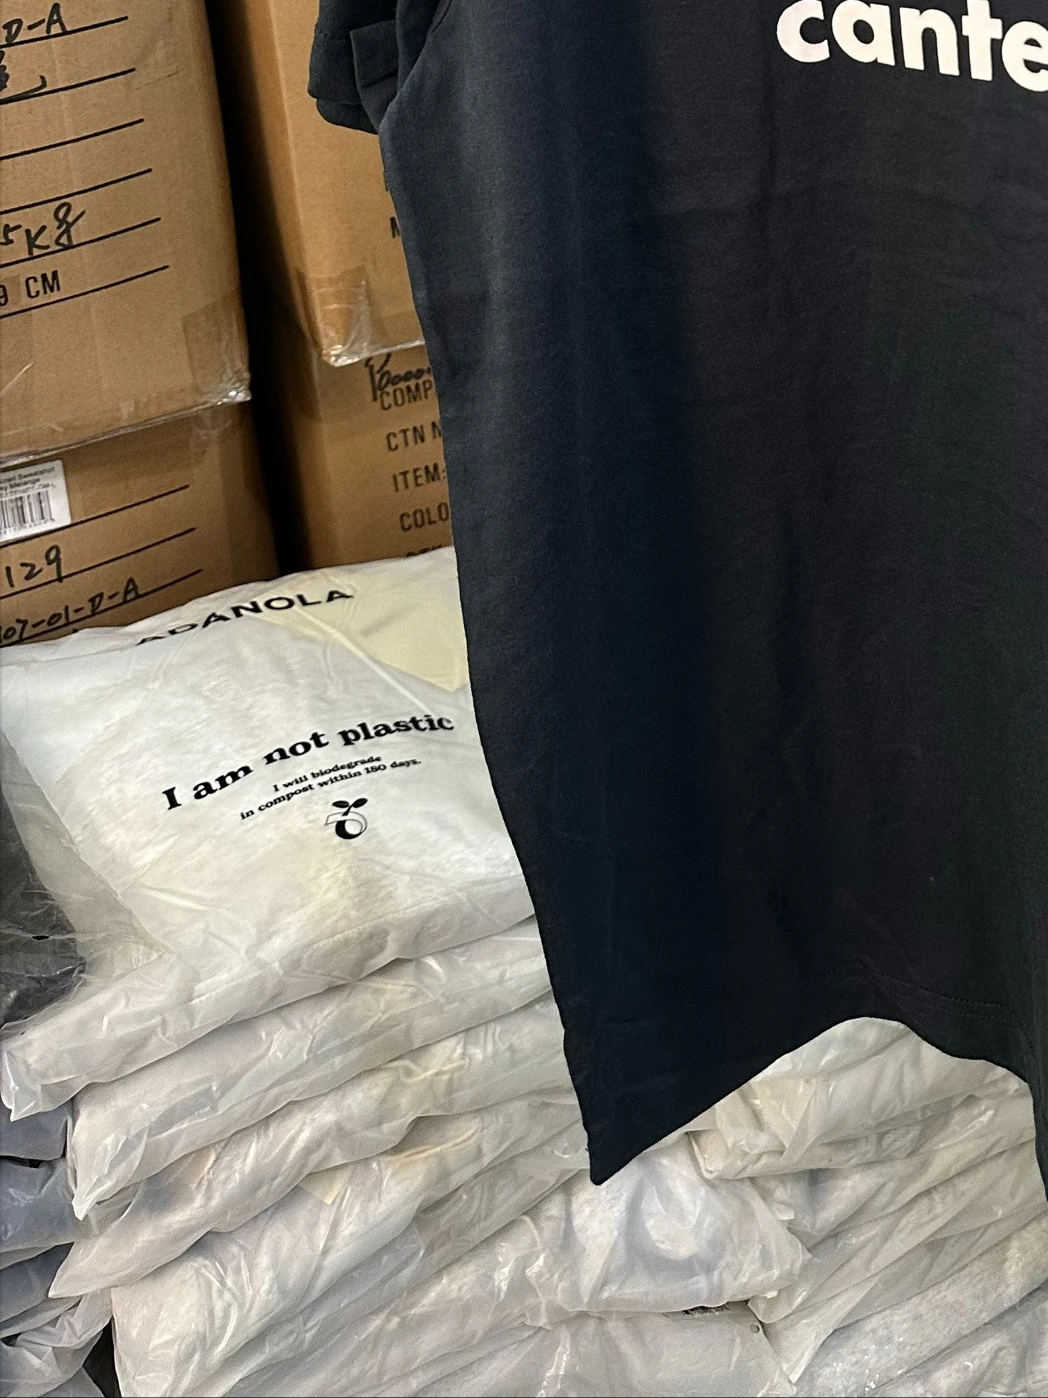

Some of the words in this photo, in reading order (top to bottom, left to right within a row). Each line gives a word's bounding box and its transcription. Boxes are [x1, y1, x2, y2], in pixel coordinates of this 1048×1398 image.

[25, 269, 60, 299] CM
[386, 424, 425, 452] CTN
[399, 502, 449, 532] COLO
[136, 588, 354, 646] ADANOLA
[162, 786, 182, 811] I
[192, 763, 253, 800] am
[263, 731, 329, 765] not
[337, 715, 455, 747] plastic
[282, 774, 309, 790] will
[311, 756, 382, 780] biodegrade
[240, 809, 255, 820] in
[258, 783, 315, 812] compost
[317, 770, 362, 788] within
[365, 763, 387, 775] 180
